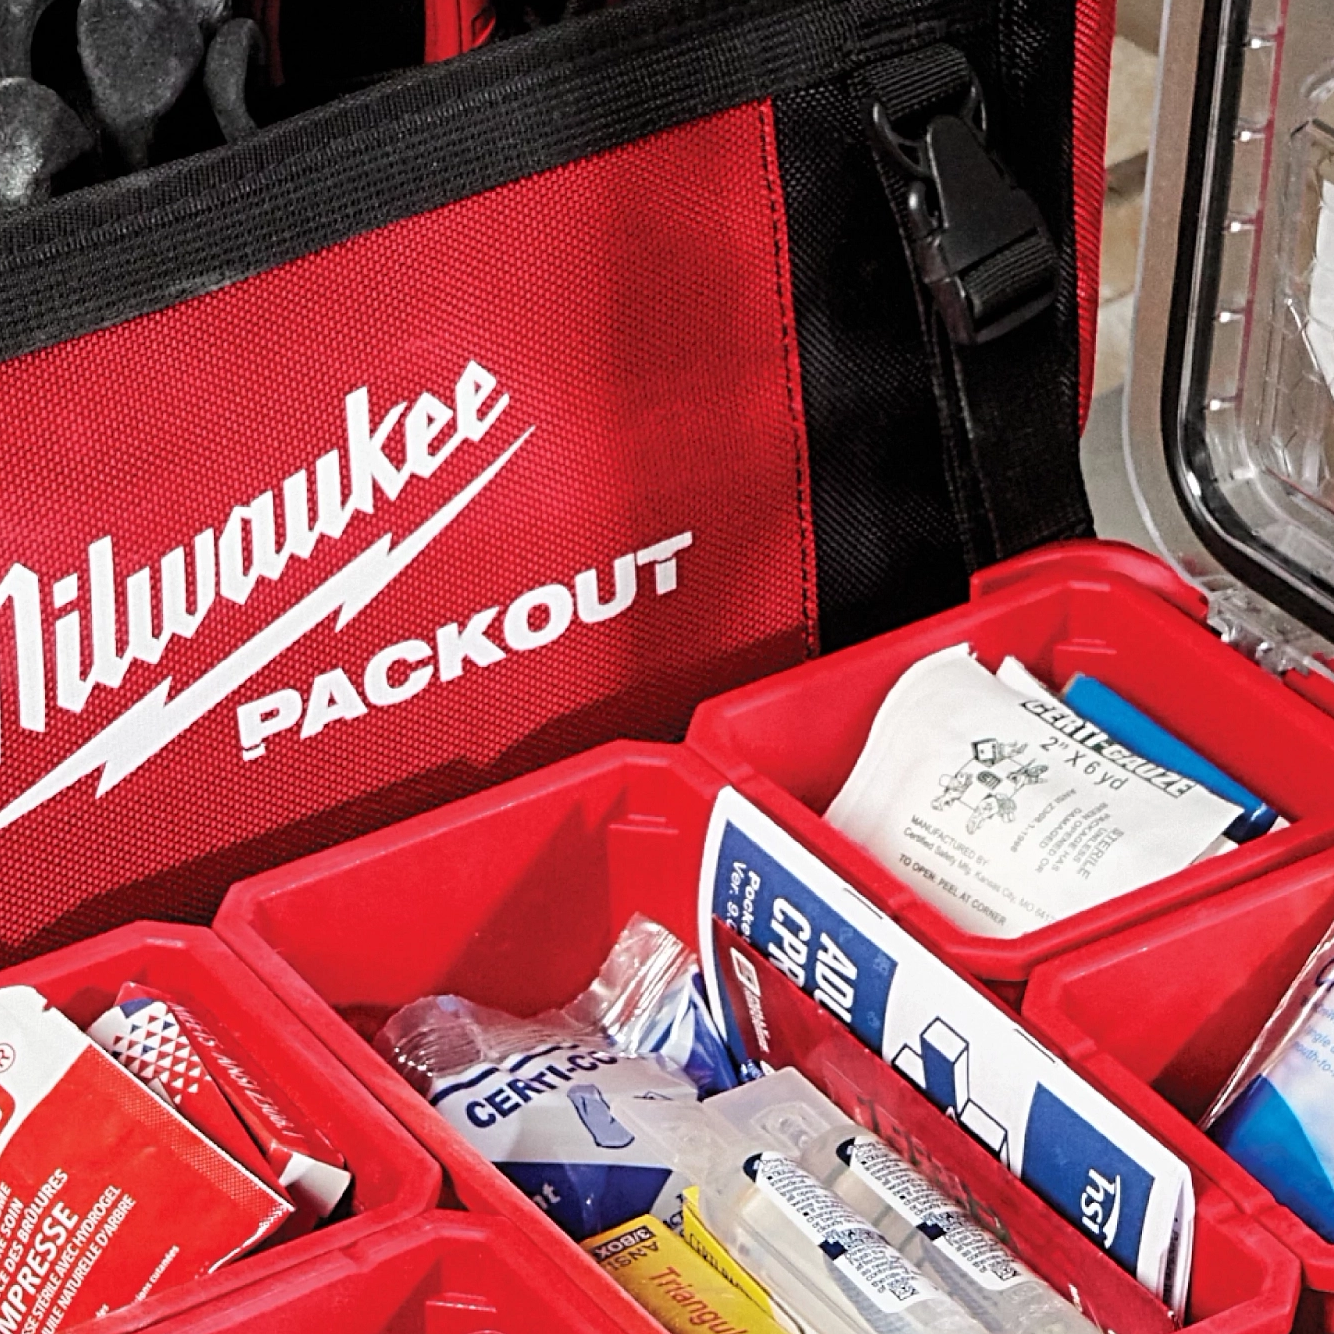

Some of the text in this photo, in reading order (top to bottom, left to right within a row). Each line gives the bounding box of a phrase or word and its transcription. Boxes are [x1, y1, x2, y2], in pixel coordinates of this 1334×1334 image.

[236, 530, 693, 762] PACKOUT
[1083, 759, 1102, 775] 6
[1093, 771, 1129, 791] yd
[910, 813, 990, 868] MANUFACTURED BY
[1075, 826, 1126, 880] STERILE
[729, 860, 747, 895] Ver.
[898, 852, 913, 868] TO
[938, 878, 959, 898] PEEL
[959, 891, 973, 904] AT
[970, 898, 1008, 927] CORNER
[768, 896, 813, 988] CPR
[0, 1196, 25, 1238] SOIN
[3, 1239, 25, 1273] DES
[16, 1167, 68, 1244] BRÛLURES
[1081, 1167, 1118, 1235] hsi
[32, 1271, 63, 1321] STÉRILE
[54, 1235, 80, 1278] AVEC
[72, 1184, 122, 1248] HYDROGEL
[57, 1243, 103, 1310] NATURELLE
[94, 1193, 137, 1248] D'ARBRE
[595, 1224, 657, 1261] 3/BOX
